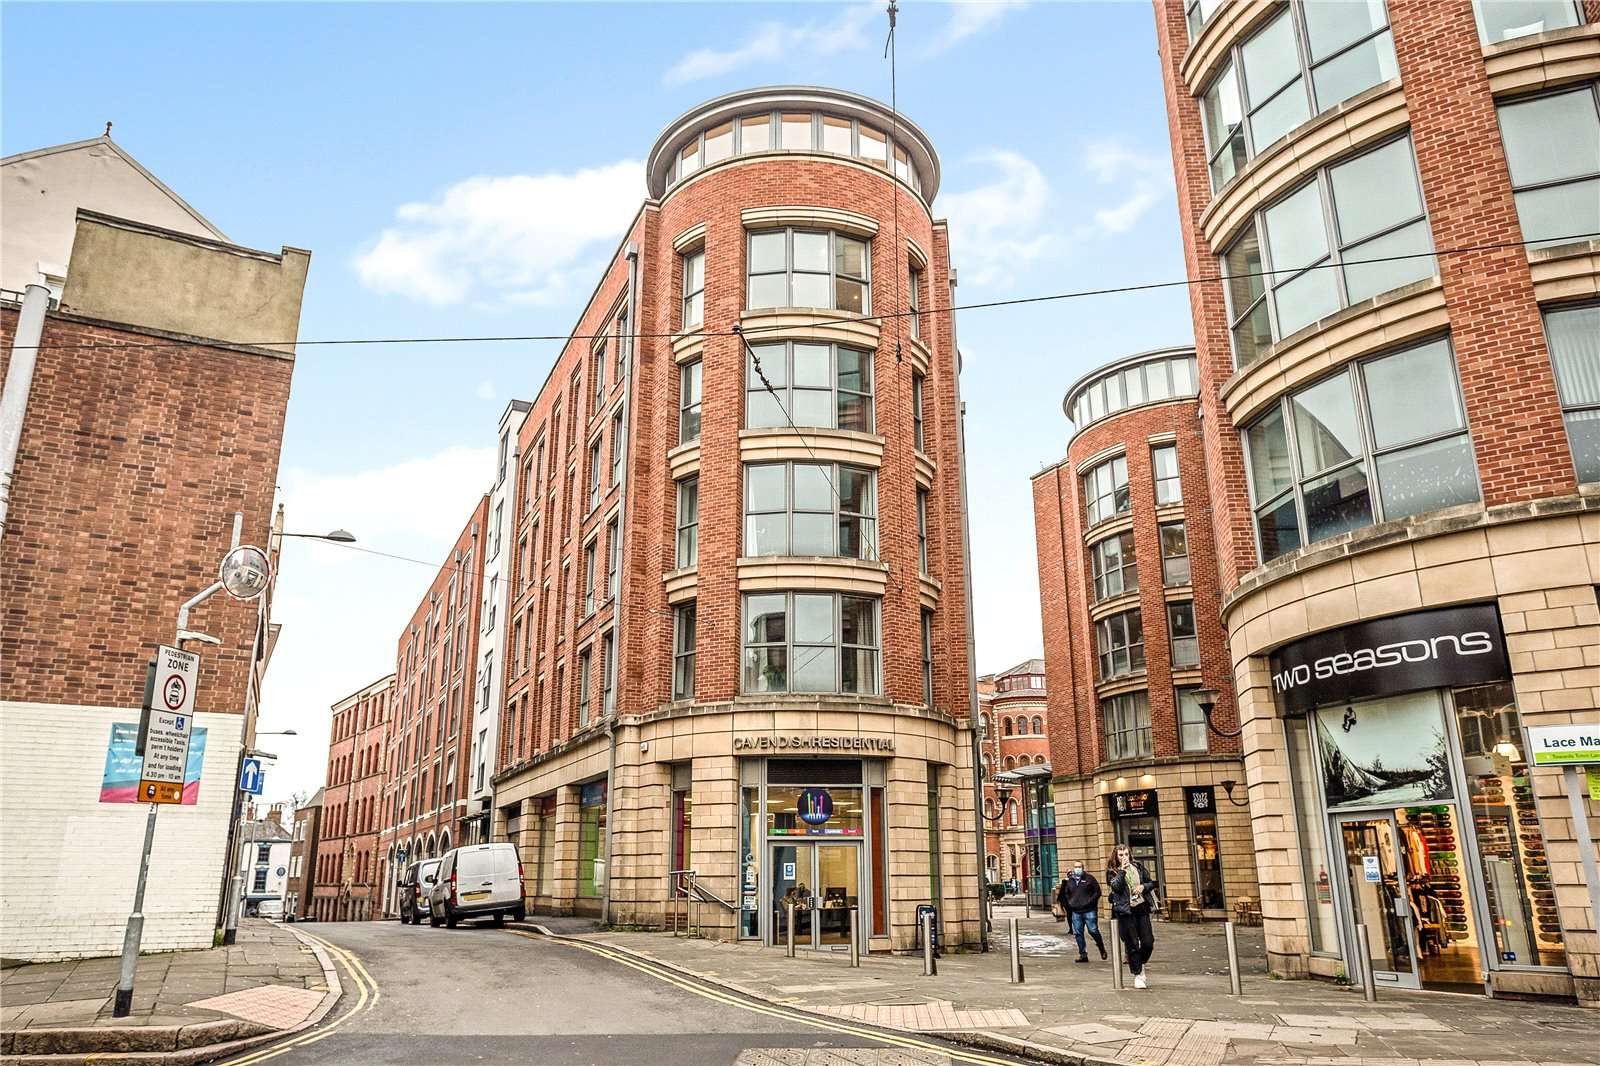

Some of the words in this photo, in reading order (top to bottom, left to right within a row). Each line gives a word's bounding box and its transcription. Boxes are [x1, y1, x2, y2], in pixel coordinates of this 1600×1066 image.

[165, 649, 195, 661] PEDESTRIAN
[168, 659, 189, 672] ZONE
[1273, 664, 1310, 693] TWO
[1543, 738, 1576, 748] Lace
[1580, 736, 1600, 746] Ma
